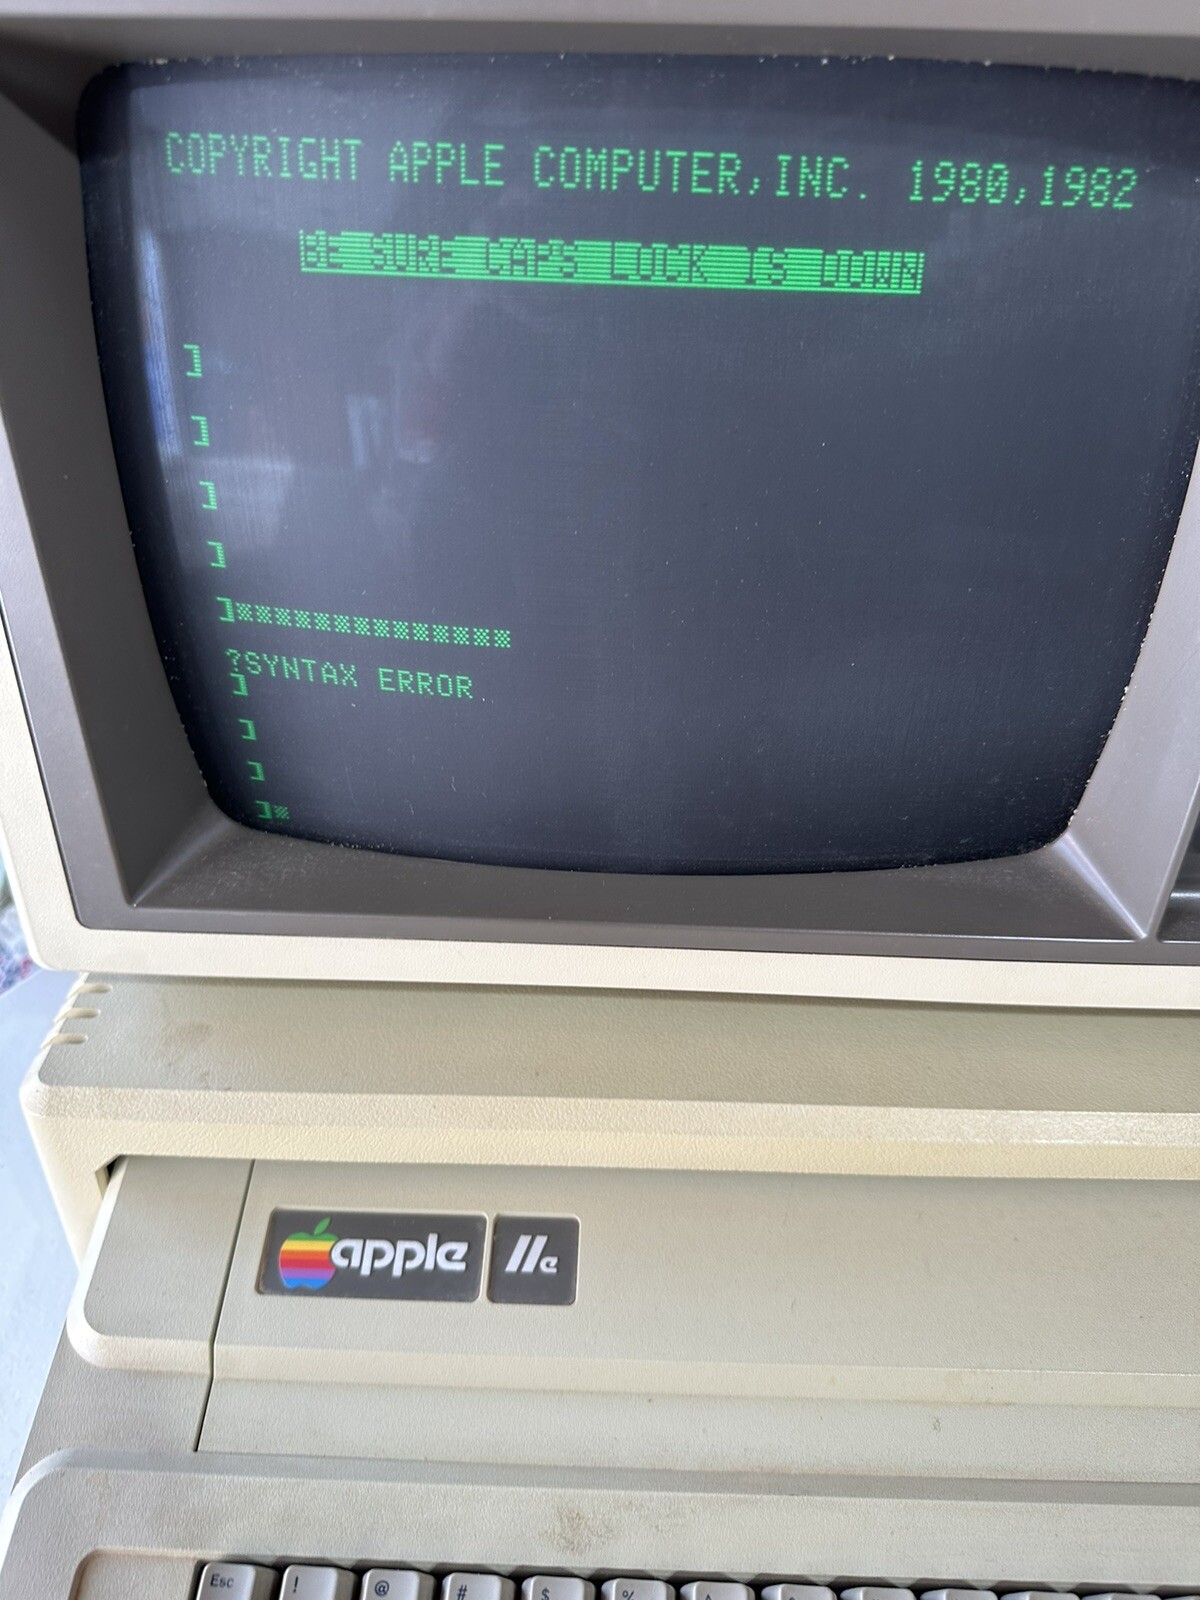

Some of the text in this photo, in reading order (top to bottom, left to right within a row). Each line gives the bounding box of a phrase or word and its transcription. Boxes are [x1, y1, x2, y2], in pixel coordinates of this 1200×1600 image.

[165, 132, 363, 181] COPYRIGHT
[388, 140, 505, 188] APPLE
[299, 229, 925, 294] BE SURE CAPS LOCK IS DOWN
[377, 667, 474, 700] ERROR
[330, 1232, 470, 1278] apple
[209, 1573, 235, 1589] Esc
[374, 1580, 391, 1597] @
